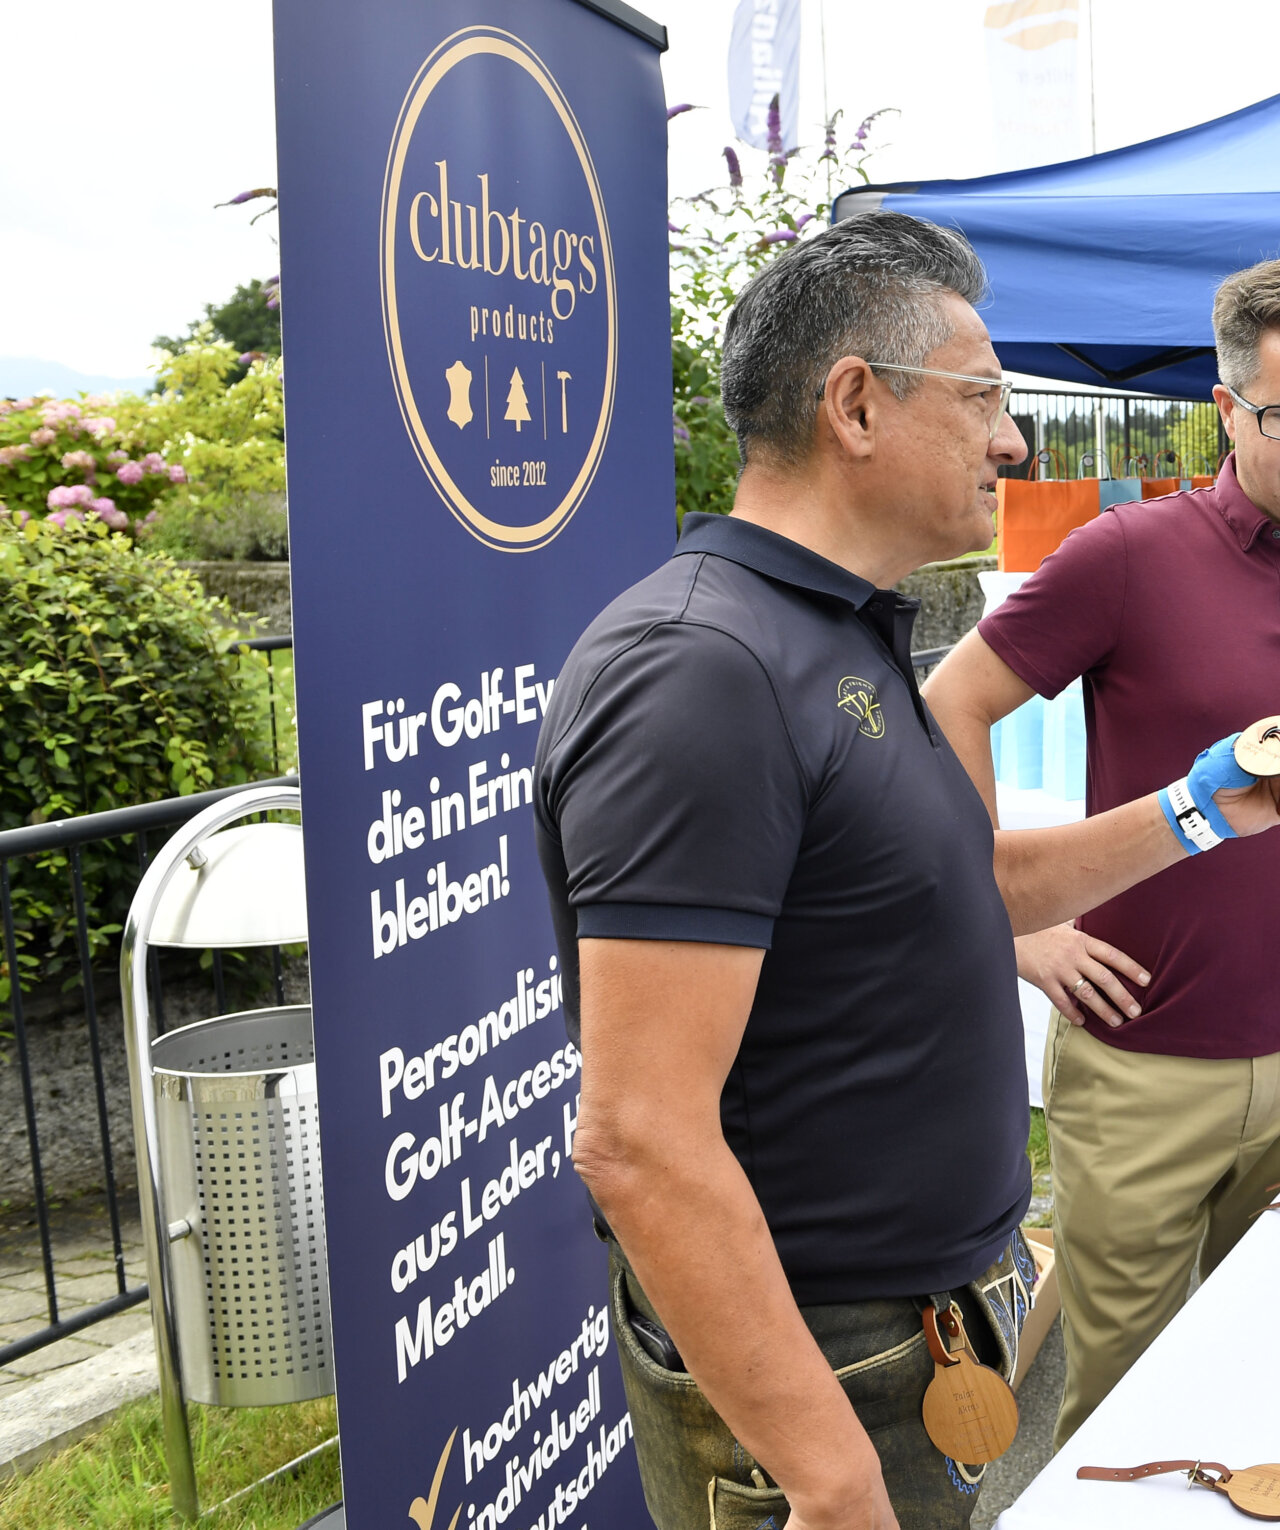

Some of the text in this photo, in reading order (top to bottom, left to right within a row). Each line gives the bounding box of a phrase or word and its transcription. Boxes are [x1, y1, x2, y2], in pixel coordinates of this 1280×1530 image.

[410, 160, 597, 320] clubtags
[470, 304, 554, 344] products
[491, 460, 547, 487] since 2012
[362, 663, 559, 771] Für Golf-Ev
[367, 753, 536, 864] die in Erin
[370, 834, 510, 960] bleiben!
[379, 955, 563, 1119] Personalisi
[391, 1210, 458, 1293] aus
[461, 1136, 561, 1240] Leder,
[395, 1231, 515, 1384] Metall.
[462, 1305, 609, 1485] hochwertig
[467, 1365, 601, 1530] individuell
